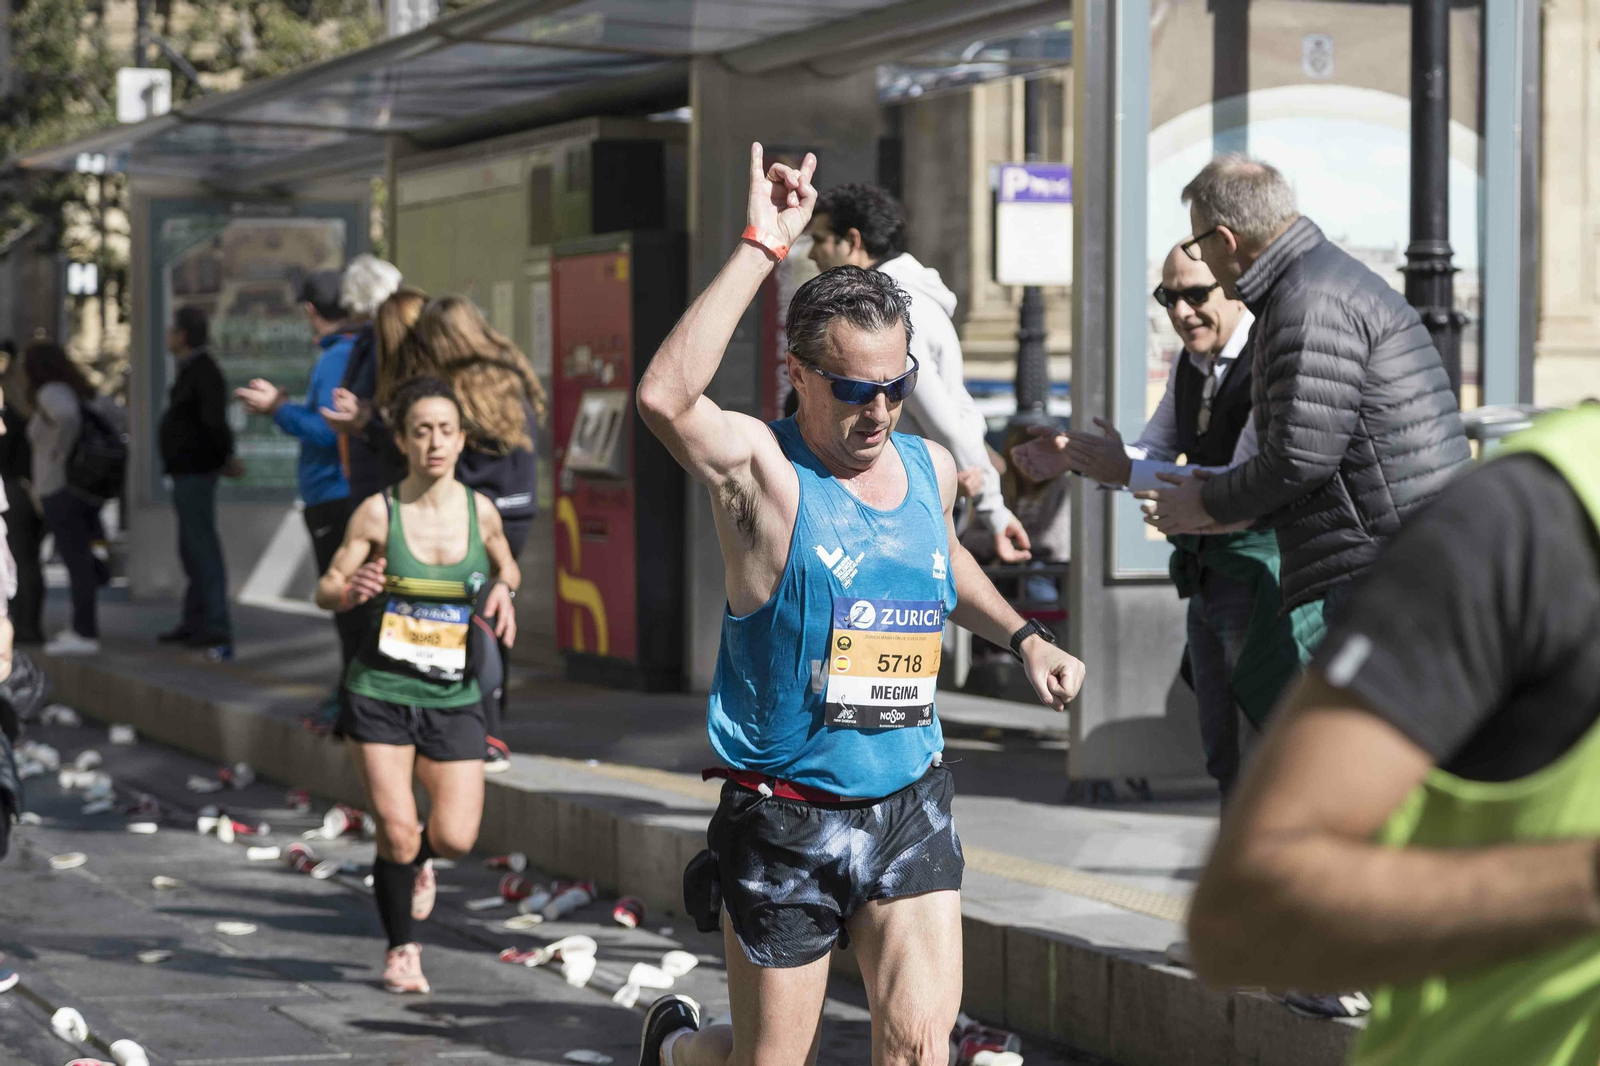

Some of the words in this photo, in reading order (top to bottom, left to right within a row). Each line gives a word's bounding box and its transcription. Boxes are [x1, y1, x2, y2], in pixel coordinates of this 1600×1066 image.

[67, 262, 98, 295] H
[881, 608, 940, 626] ZURICH
[877, 654, 922, 673] 5718
[870, 685, 919, 700] MEGINA
